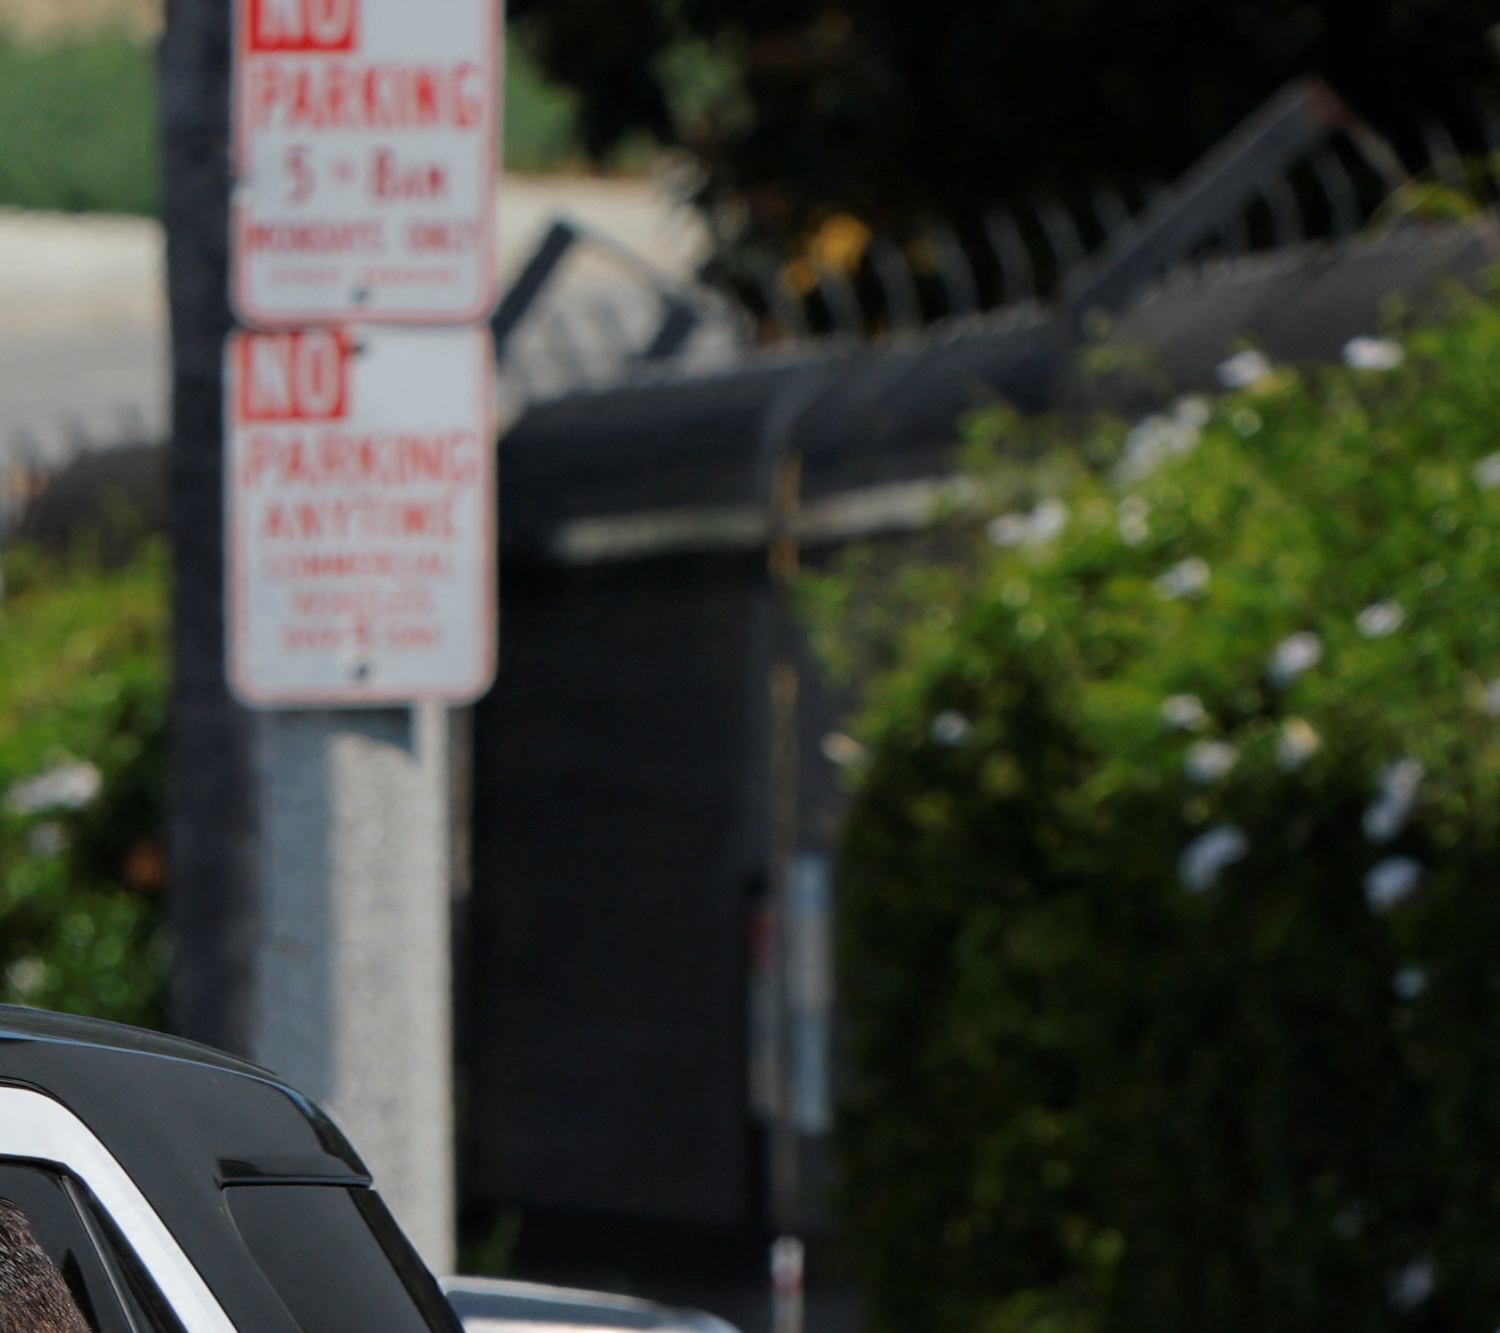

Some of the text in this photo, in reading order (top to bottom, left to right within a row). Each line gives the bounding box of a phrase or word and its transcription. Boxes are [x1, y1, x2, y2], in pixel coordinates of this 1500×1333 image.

[252, 61, 483, 132] PARKING
[248, 333, 340, 415] NO
[243, 428, 479, 486] PARKING
[260, 494, 458, 542] ANYTIME
